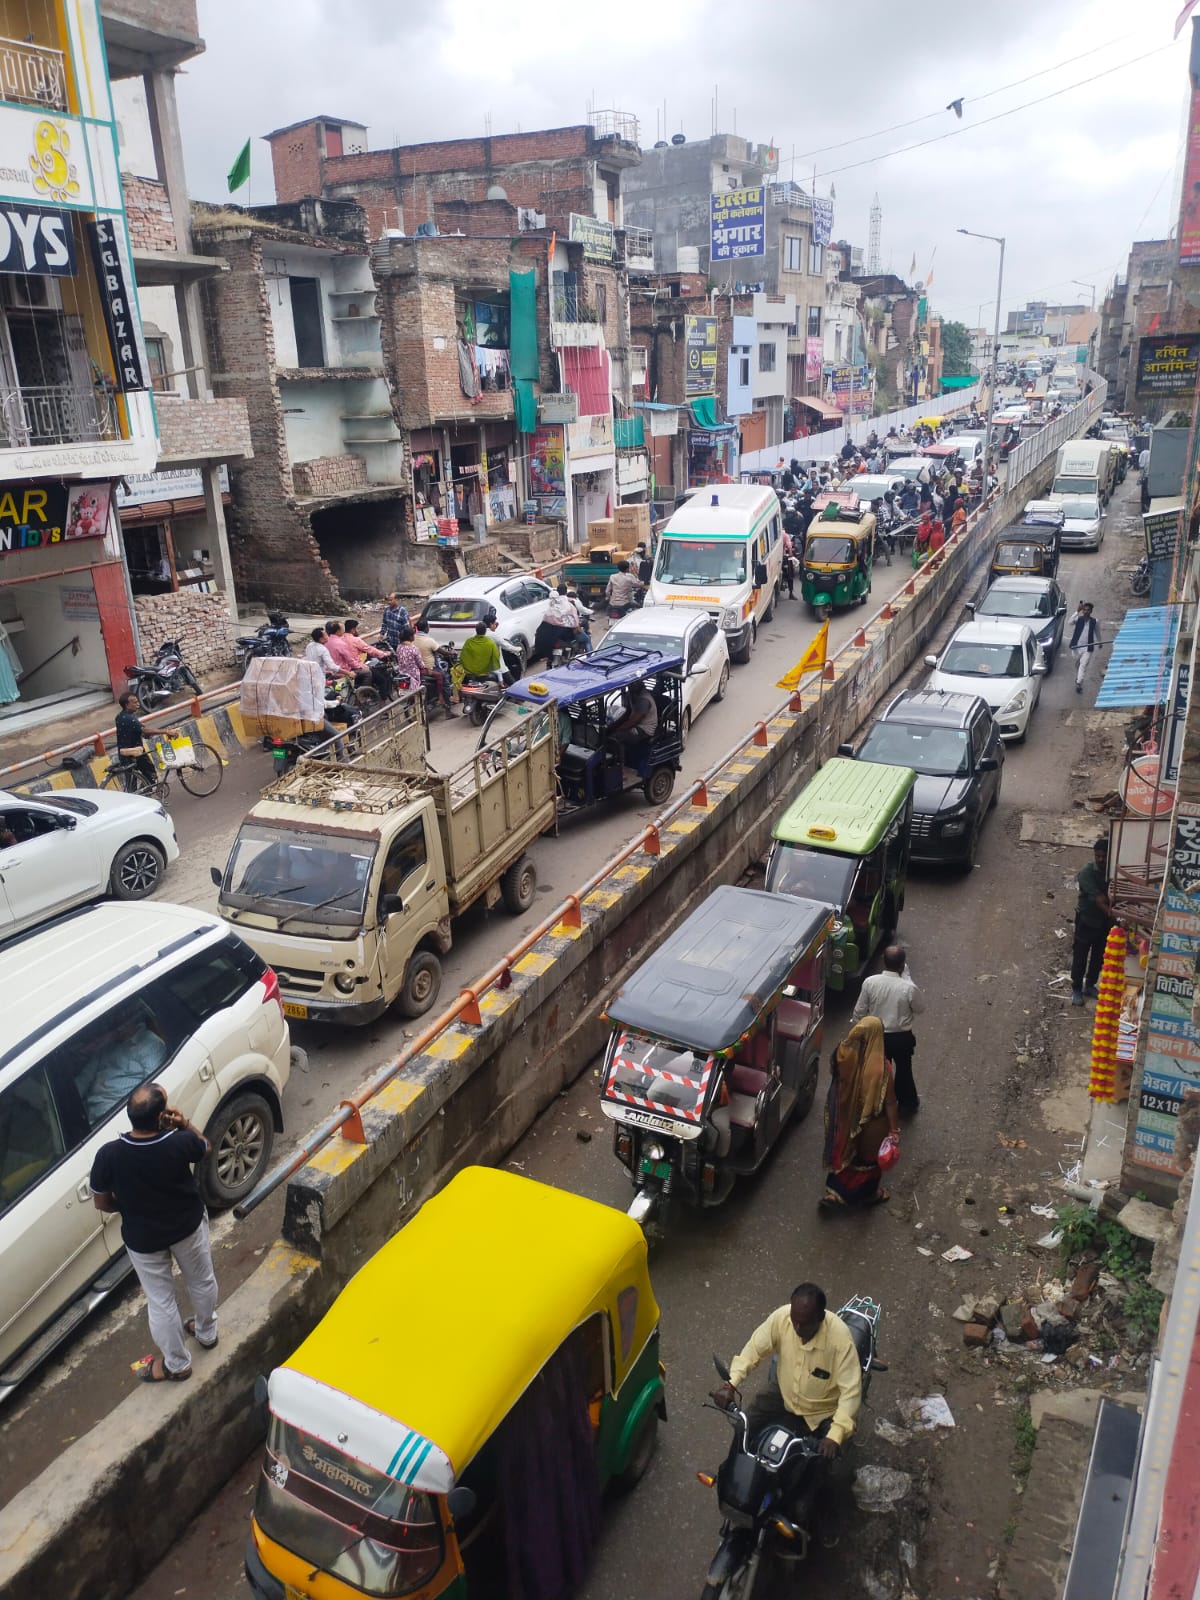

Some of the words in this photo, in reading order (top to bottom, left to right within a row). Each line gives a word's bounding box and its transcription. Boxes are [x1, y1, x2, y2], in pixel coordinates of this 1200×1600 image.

[714, 188, 760, 208] उत्सव
[712, 223, 763, 244] श्रंगार
[717, 246, 729, 257] की
[732, 243, 759, 258] दुकान
[1155, 345, 1189, 359] हर्षित
[314, 1457, 373, 1497] महाकाल
